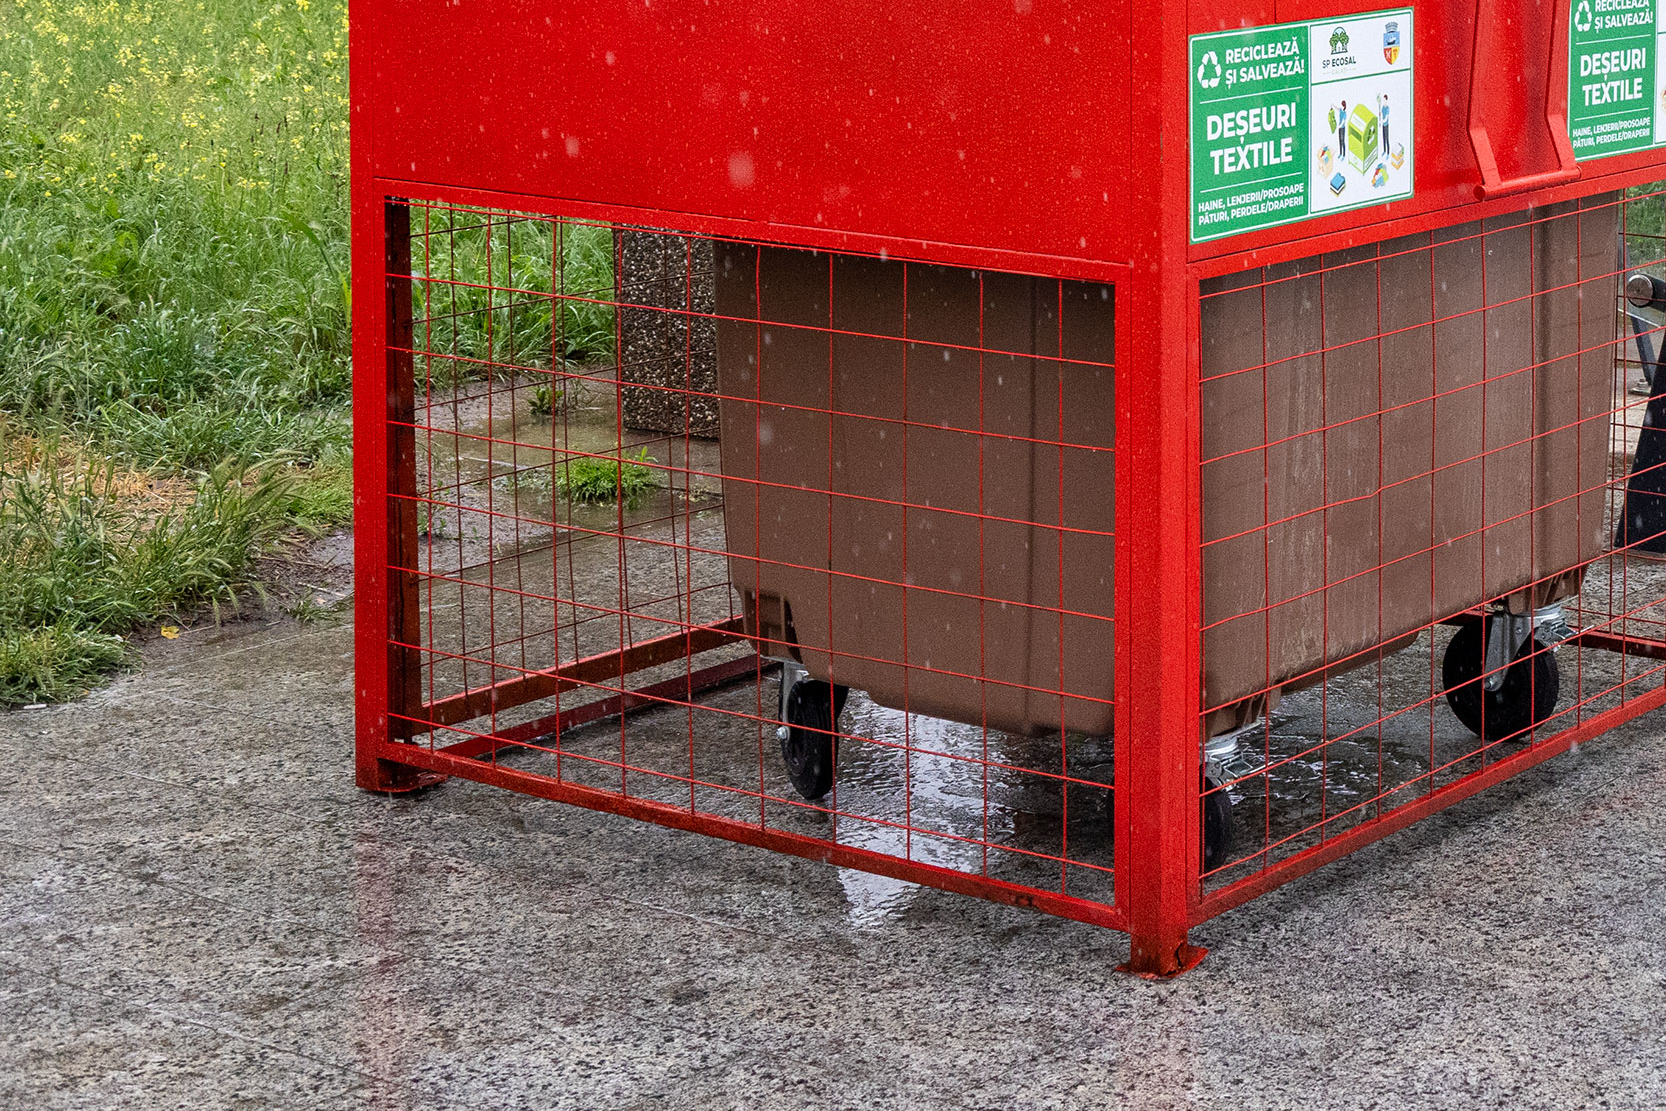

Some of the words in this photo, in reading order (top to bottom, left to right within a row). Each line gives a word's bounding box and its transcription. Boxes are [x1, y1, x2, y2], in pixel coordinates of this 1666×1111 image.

[1595, 18, 1604, 33] ȘI
[1605, 11, 1653, 29] SALVEAZĂ!
[1225, 36, 1300, 65] RECICLEAZĂ
[1322, 59, 1331, 69] SP
[1332, 55, 1357, 68] ECOSAL
[1580, 48, 1646, 81] DEȘEURI
[1225, 70, 1238, 89] ȘI
[1239, 56, 1305, 83] SALVEAZĂ!
[1582, 77, 1643, 107] TEXTILE
[1206, 102, 1297, 145] DEȘEURI
[1573, 126, 1593, 138] HAINE,
[1593, 117, 1650, 135] LENJERII/PROSOAPE
[1573, 136, 1596, 149] PĂTURI,
[1596, 126, 1650, 146] PERDELE/DRAPERII
[1210, 138, 1293, 176] TEXTILE
[1198, 197, 1226, 213] HAINE,
[1227, 183, 1305, 208] LENJERII/PROSOAPE
[1199, 208, 1230, 226] PĂTURI,
[1231, 195, 1304, 221] PERDELE/DRAPERII
